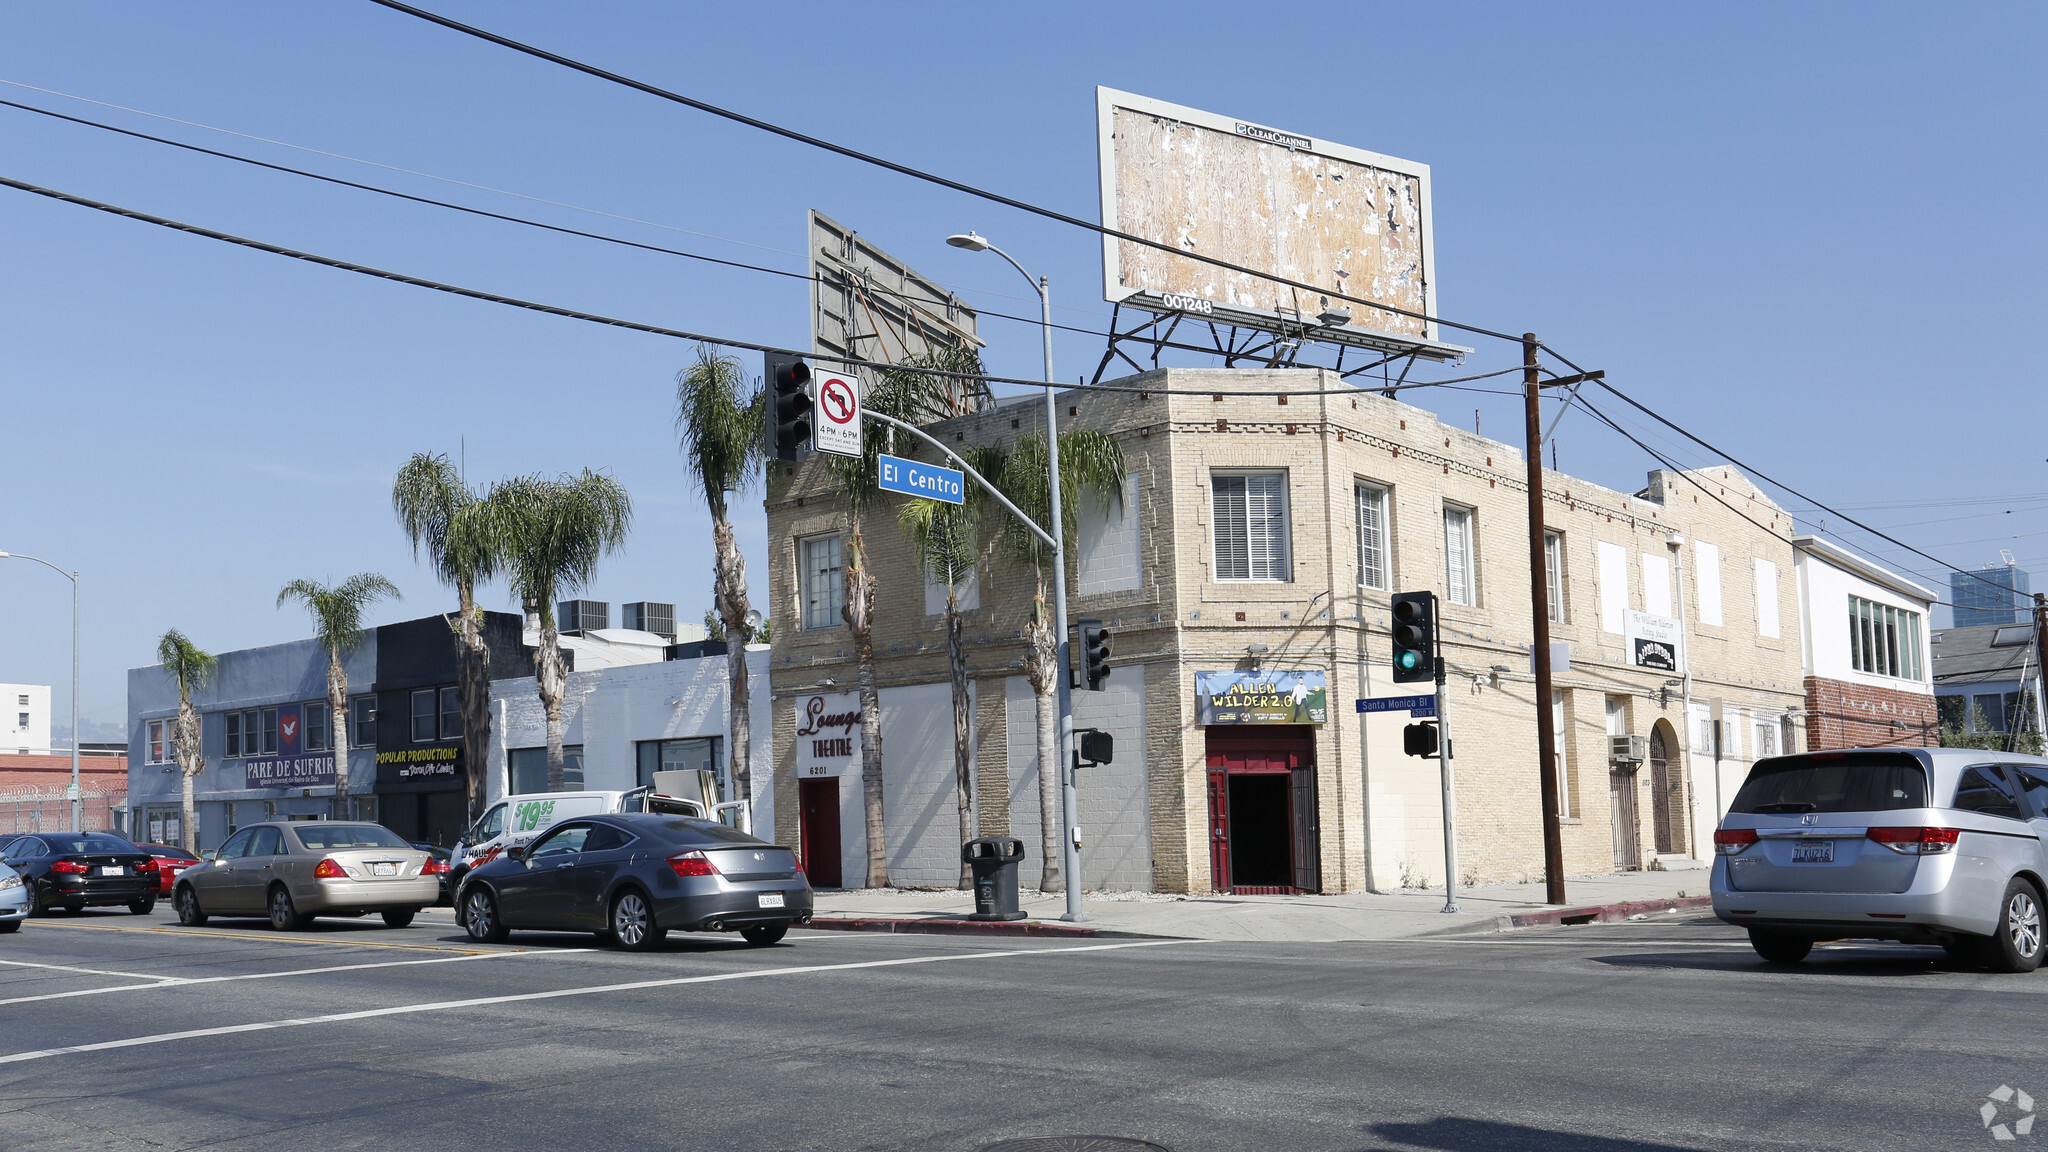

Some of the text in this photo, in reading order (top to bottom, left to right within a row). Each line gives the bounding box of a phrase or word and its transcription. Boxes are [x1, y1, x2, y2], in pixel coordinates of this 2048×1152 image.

[1163, 294, 1212, 314] 001248
[819, 425, 825, 433] 4
[826, 426, 836, 436] PM
[842, 429, 848, 438] 6
[848, 430, 858, 440] PM
[884, 463, 959, 495] El Centro
[1229, 683, 1276, 695] ALLEN
[1212, 695, 1293, 708] WILDER 2.0
[1362, 697, 1428, 710] Santa Monica Bl
[797, 696, 862, 736] Lounge
[1411, 709, 1426, 717] 6200
[376, 747, 458, 764] POPULAR PRODUCTIONS
[812, 738, 852, 758] THEATRE
[247, 757, 334, 779] PARE DE SUFRIR
[809, 766, 827, 775] 6201
[1794, 848, 1830, 860] 7LKU216
